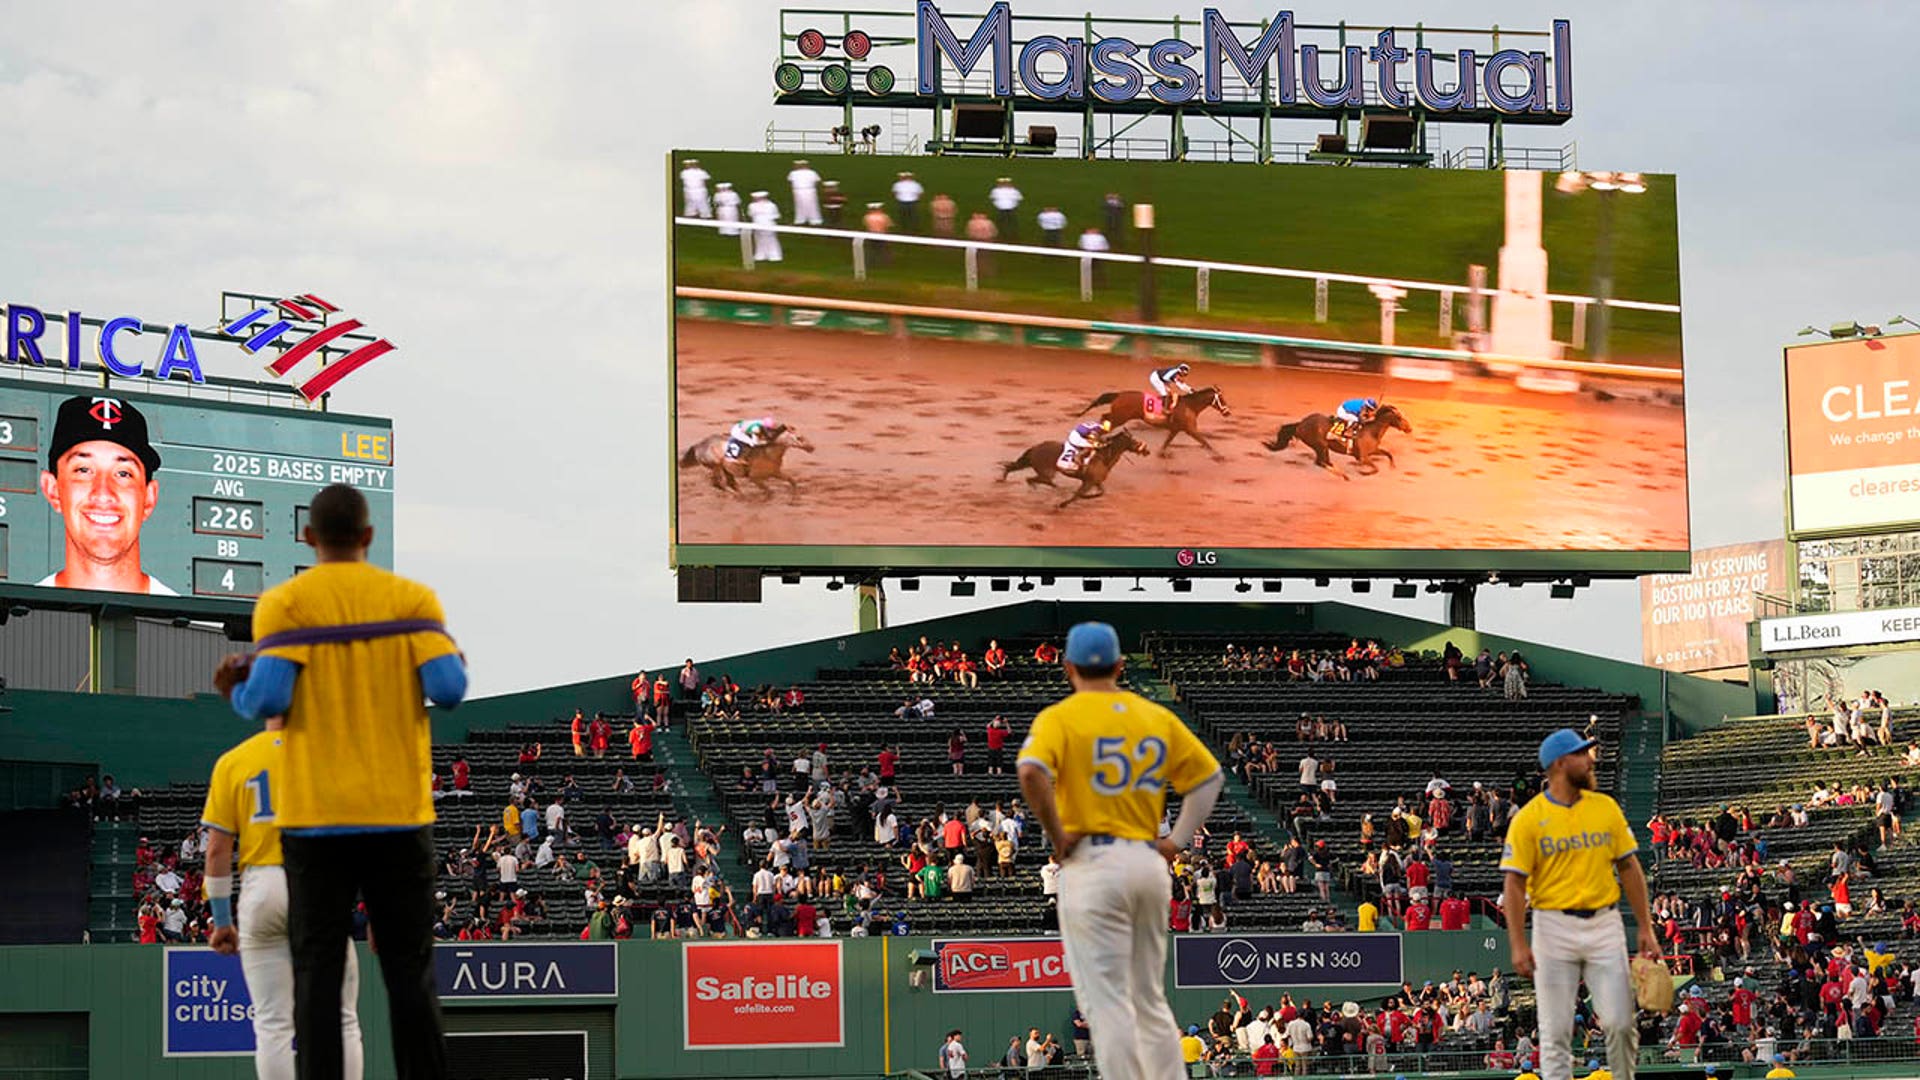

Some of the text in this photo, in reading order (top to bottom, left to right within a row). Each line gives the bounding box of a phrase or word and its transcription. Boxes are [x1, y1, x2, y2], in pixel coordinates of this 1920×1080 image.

[917, 0, 1572, 113] MassMutual
[5, 303, 206, 384] RICA
[1822, 380, 1920, 423] CLE
[342, 432, 388, 461] LEE
[1829, 432, 1852, 446] We
[1855, 430, 1903, 444] change
[212, 454, 387, 488] 2025 BASES EMPTY
[212, 479, 245, 497] AVG
[202, 506, 254, 531] .226
[217, 539, 239, 557] BB
[1196, 551, 1217, 565] LG
[1711, 553, 1767, 577] SERVING
[221, 568, 235, 591] 4
[1653, 572, 1769, 605] BOSTON FOR 92 OF
[1652, 605, 1680, 625] OUR
[1683, 602, 1706, 620] 100
[1666, 649, 1703, 663] DELTA
[1090, 736, 1168, 796] 52
[245, 769, 276, 823] 1
[1483, 937, 1497, 950] 40
[950, 953, 1009, 975] ACE
[1265, 951, 1361, 969] NESN 360
[175, 975, 228, 1002] city
[695, 974, 832, 1001] Safelite
[734, 1003, 795, 1014] safelite.com
